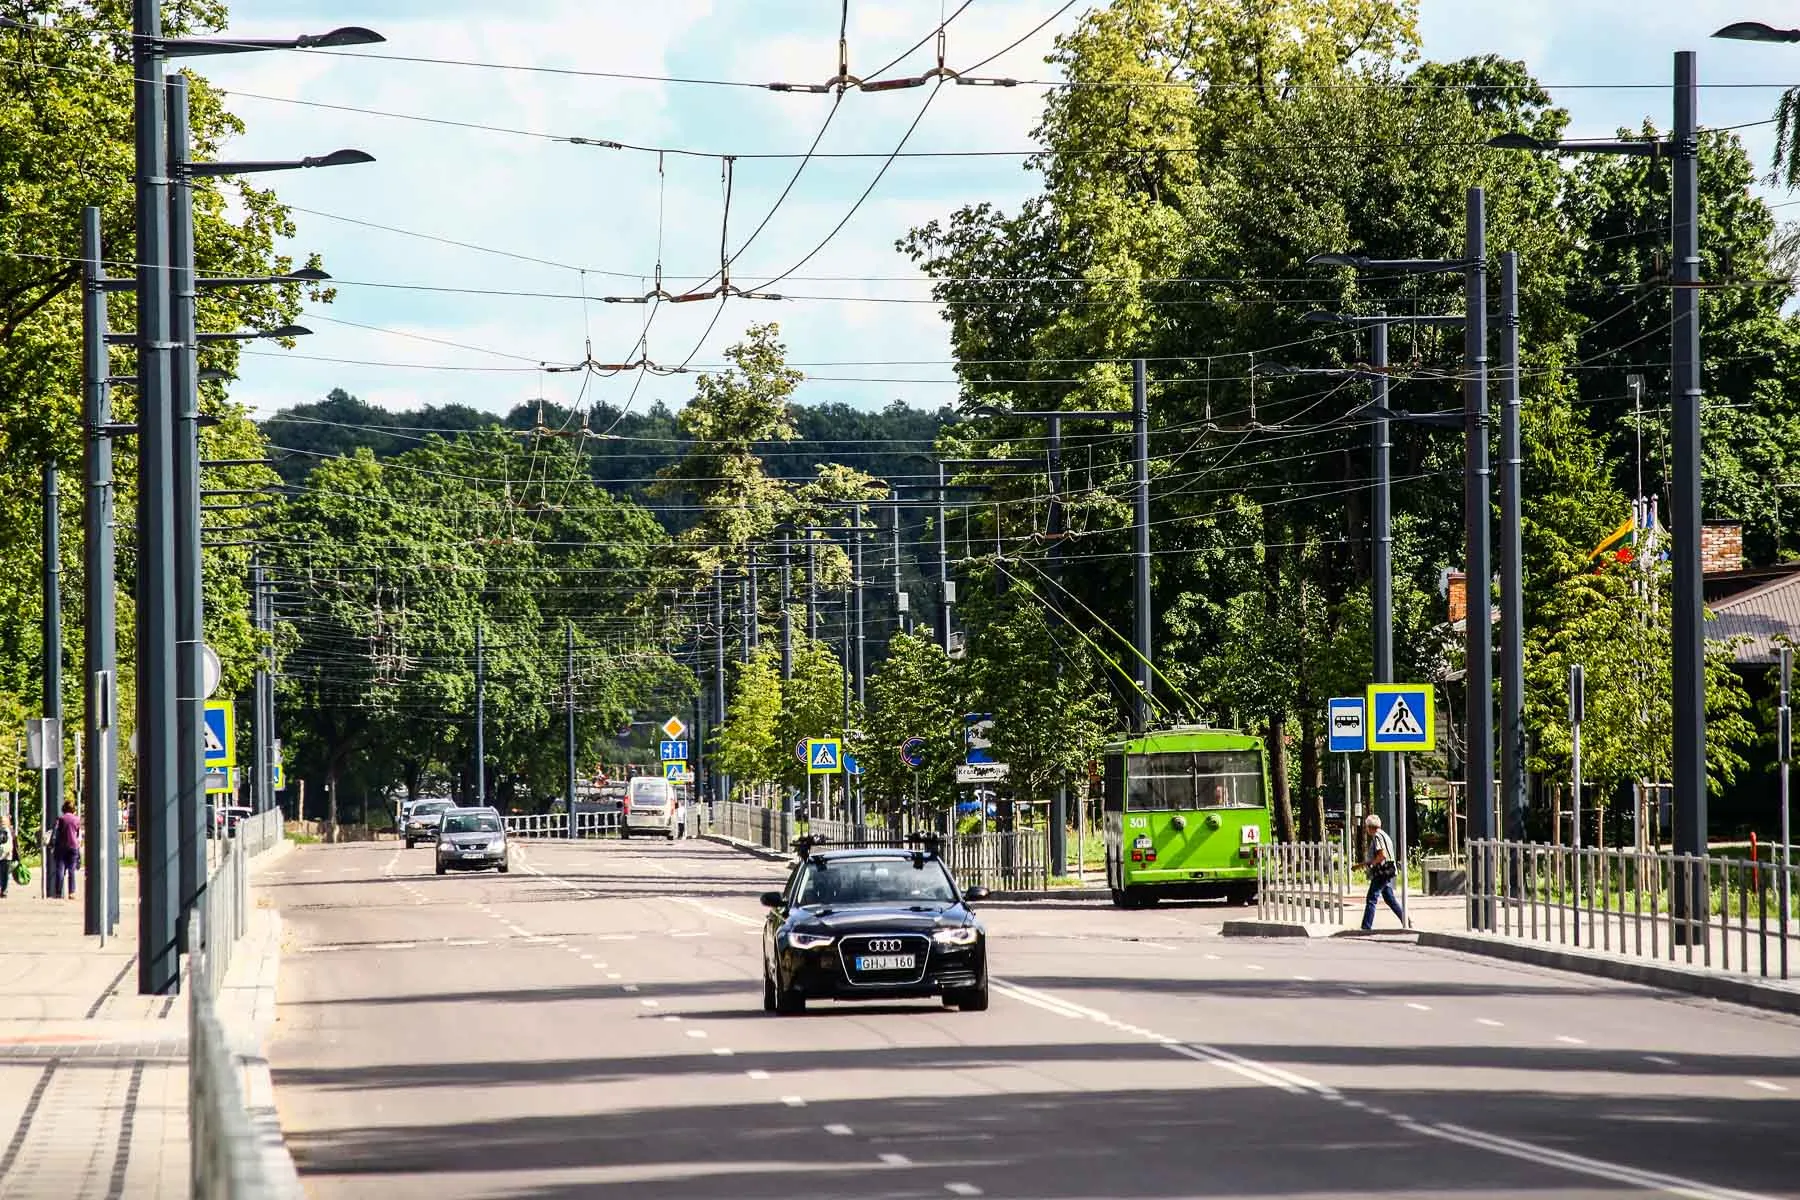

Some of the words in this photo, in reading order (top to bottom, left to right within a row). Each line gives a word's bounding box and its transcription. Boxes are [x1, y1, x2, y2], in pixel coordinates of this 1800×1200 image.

[1247, 828, 1255, 840] 4
[862, 957, 887, 969] GHJ
[895, 956, 913, 968] 160
